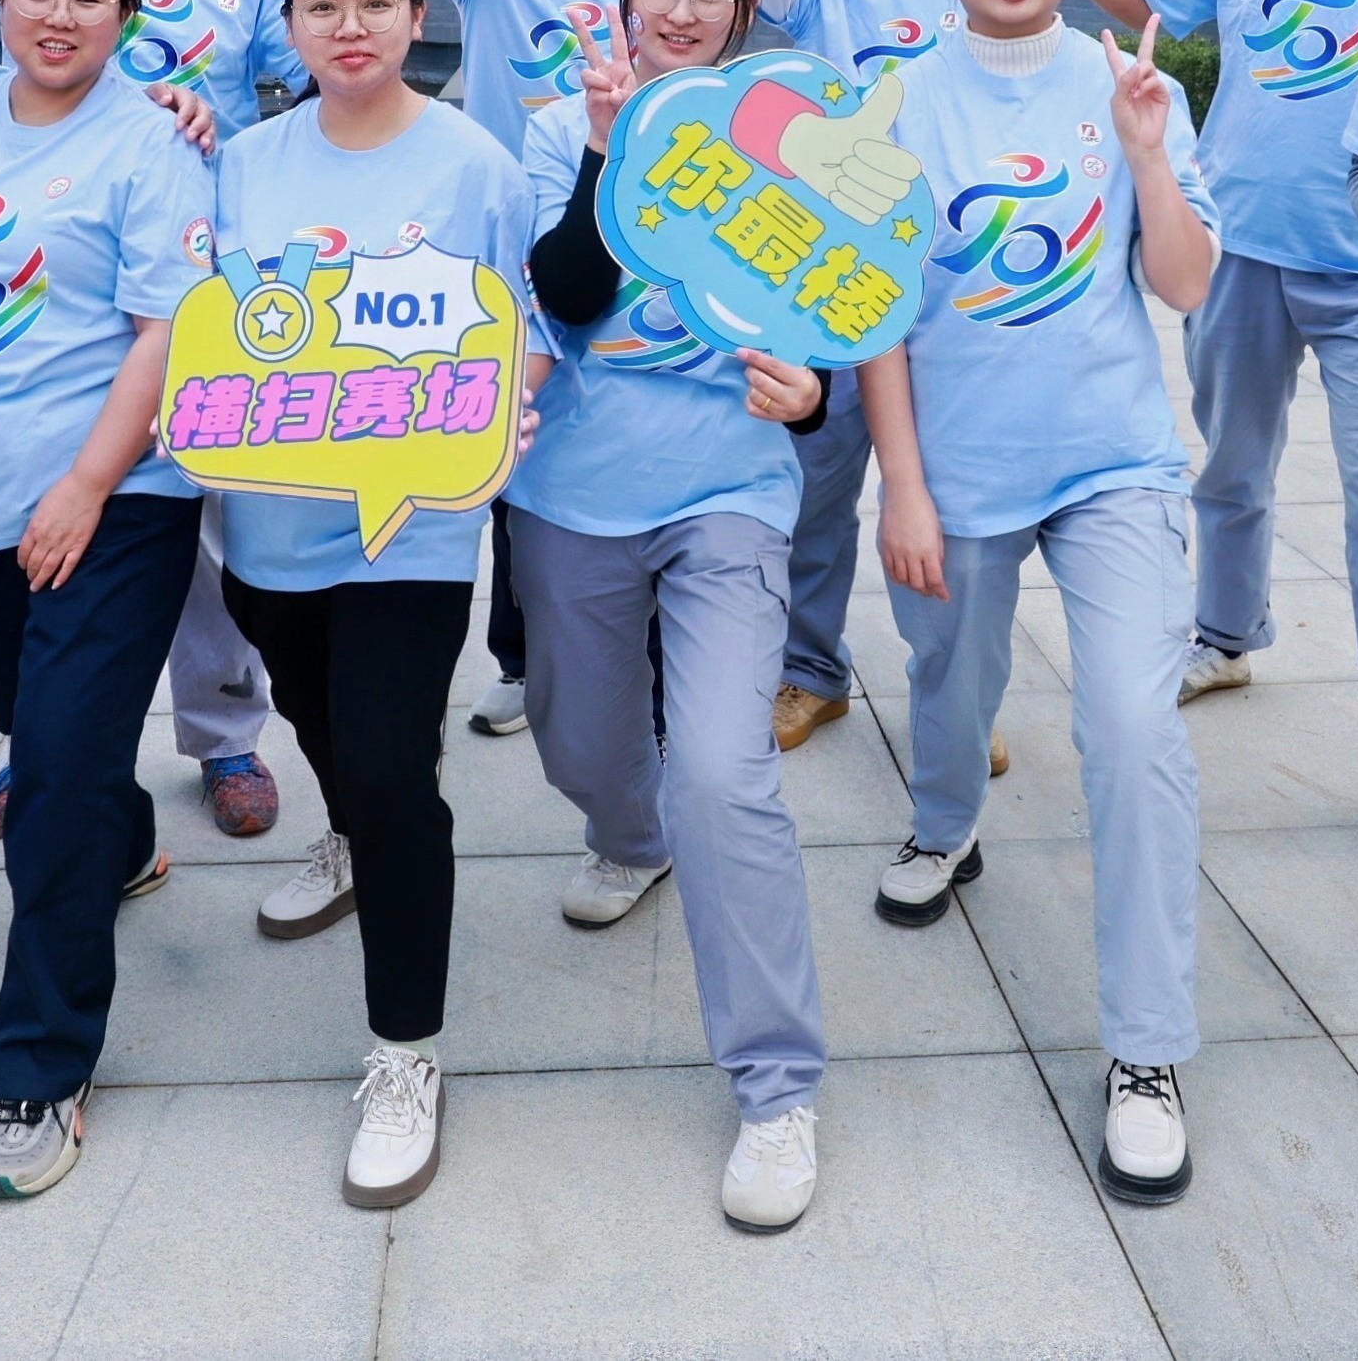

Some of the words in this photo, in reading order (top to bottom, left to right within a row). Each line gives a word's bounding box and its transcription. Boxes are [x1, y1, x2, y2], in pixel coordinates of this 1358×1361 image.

[1080, 135, 1100, 143] CSPC
[643, 120, 905, 345] 你最棒
[354, 291, 446, 328] NO.1
[167, 358, 501, 451] 横扫赛场
